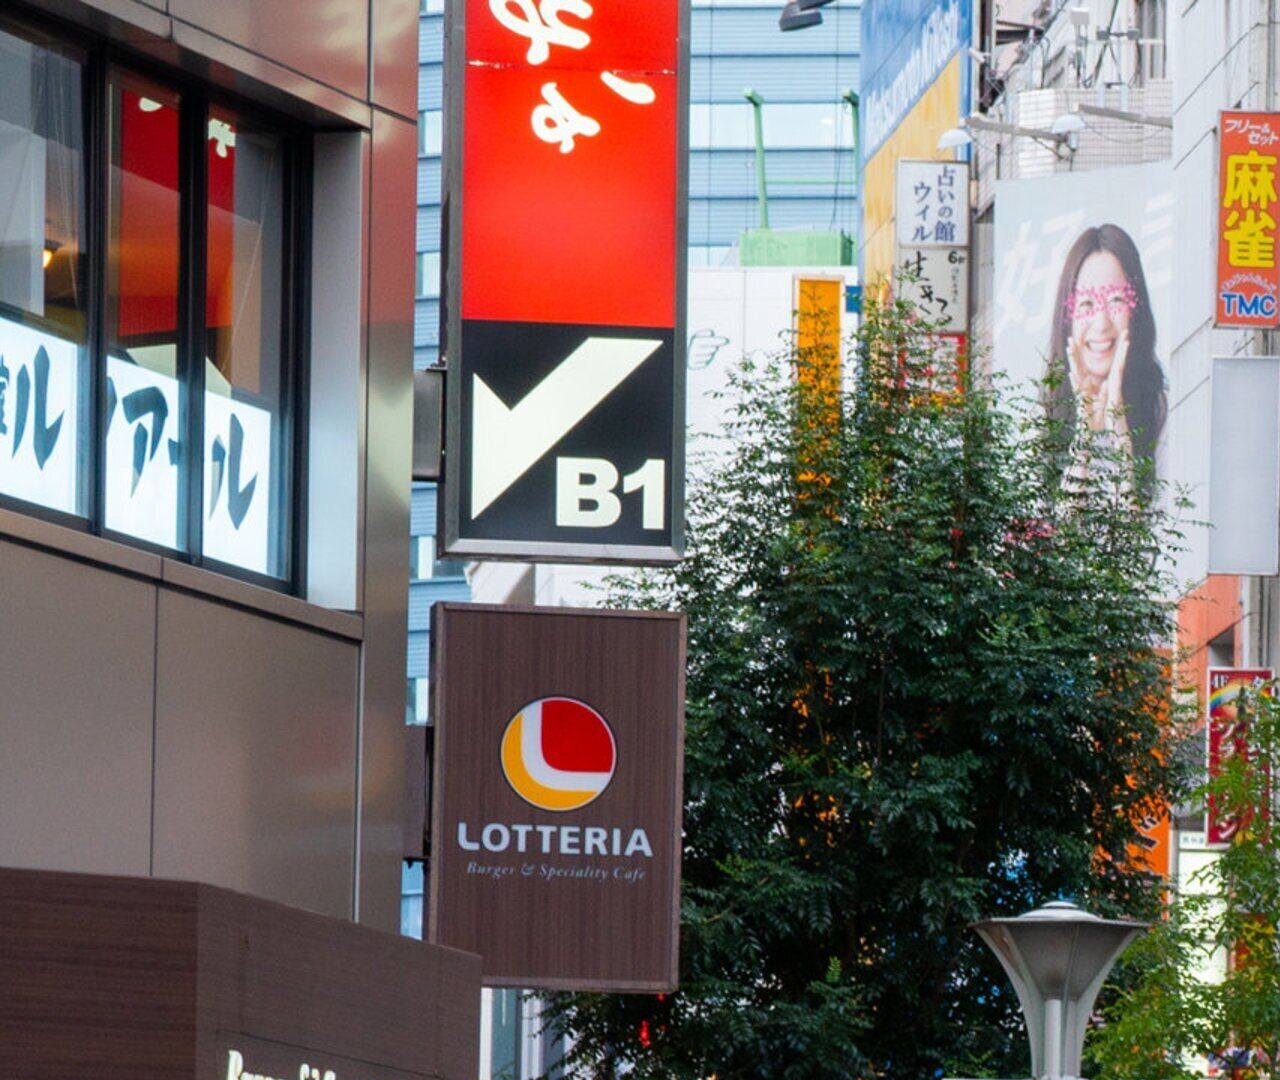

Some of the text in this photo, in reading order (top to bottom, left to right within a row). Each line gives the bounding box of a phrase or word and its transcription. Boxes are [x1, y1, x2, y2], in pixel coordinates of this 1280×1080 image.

[1248, 131, 1279, 146] セット
[934, 165, 957, 242] 占いの館
[1223, 149, 1278, 268] 麻雀
[1221, 292, 1278, 316] TMC
[555, 456, 665, 531] B1
[457, 821, 654, 858] LOTTERIA
[466, 861, 647, 883] Burger & Speciality Cafe
